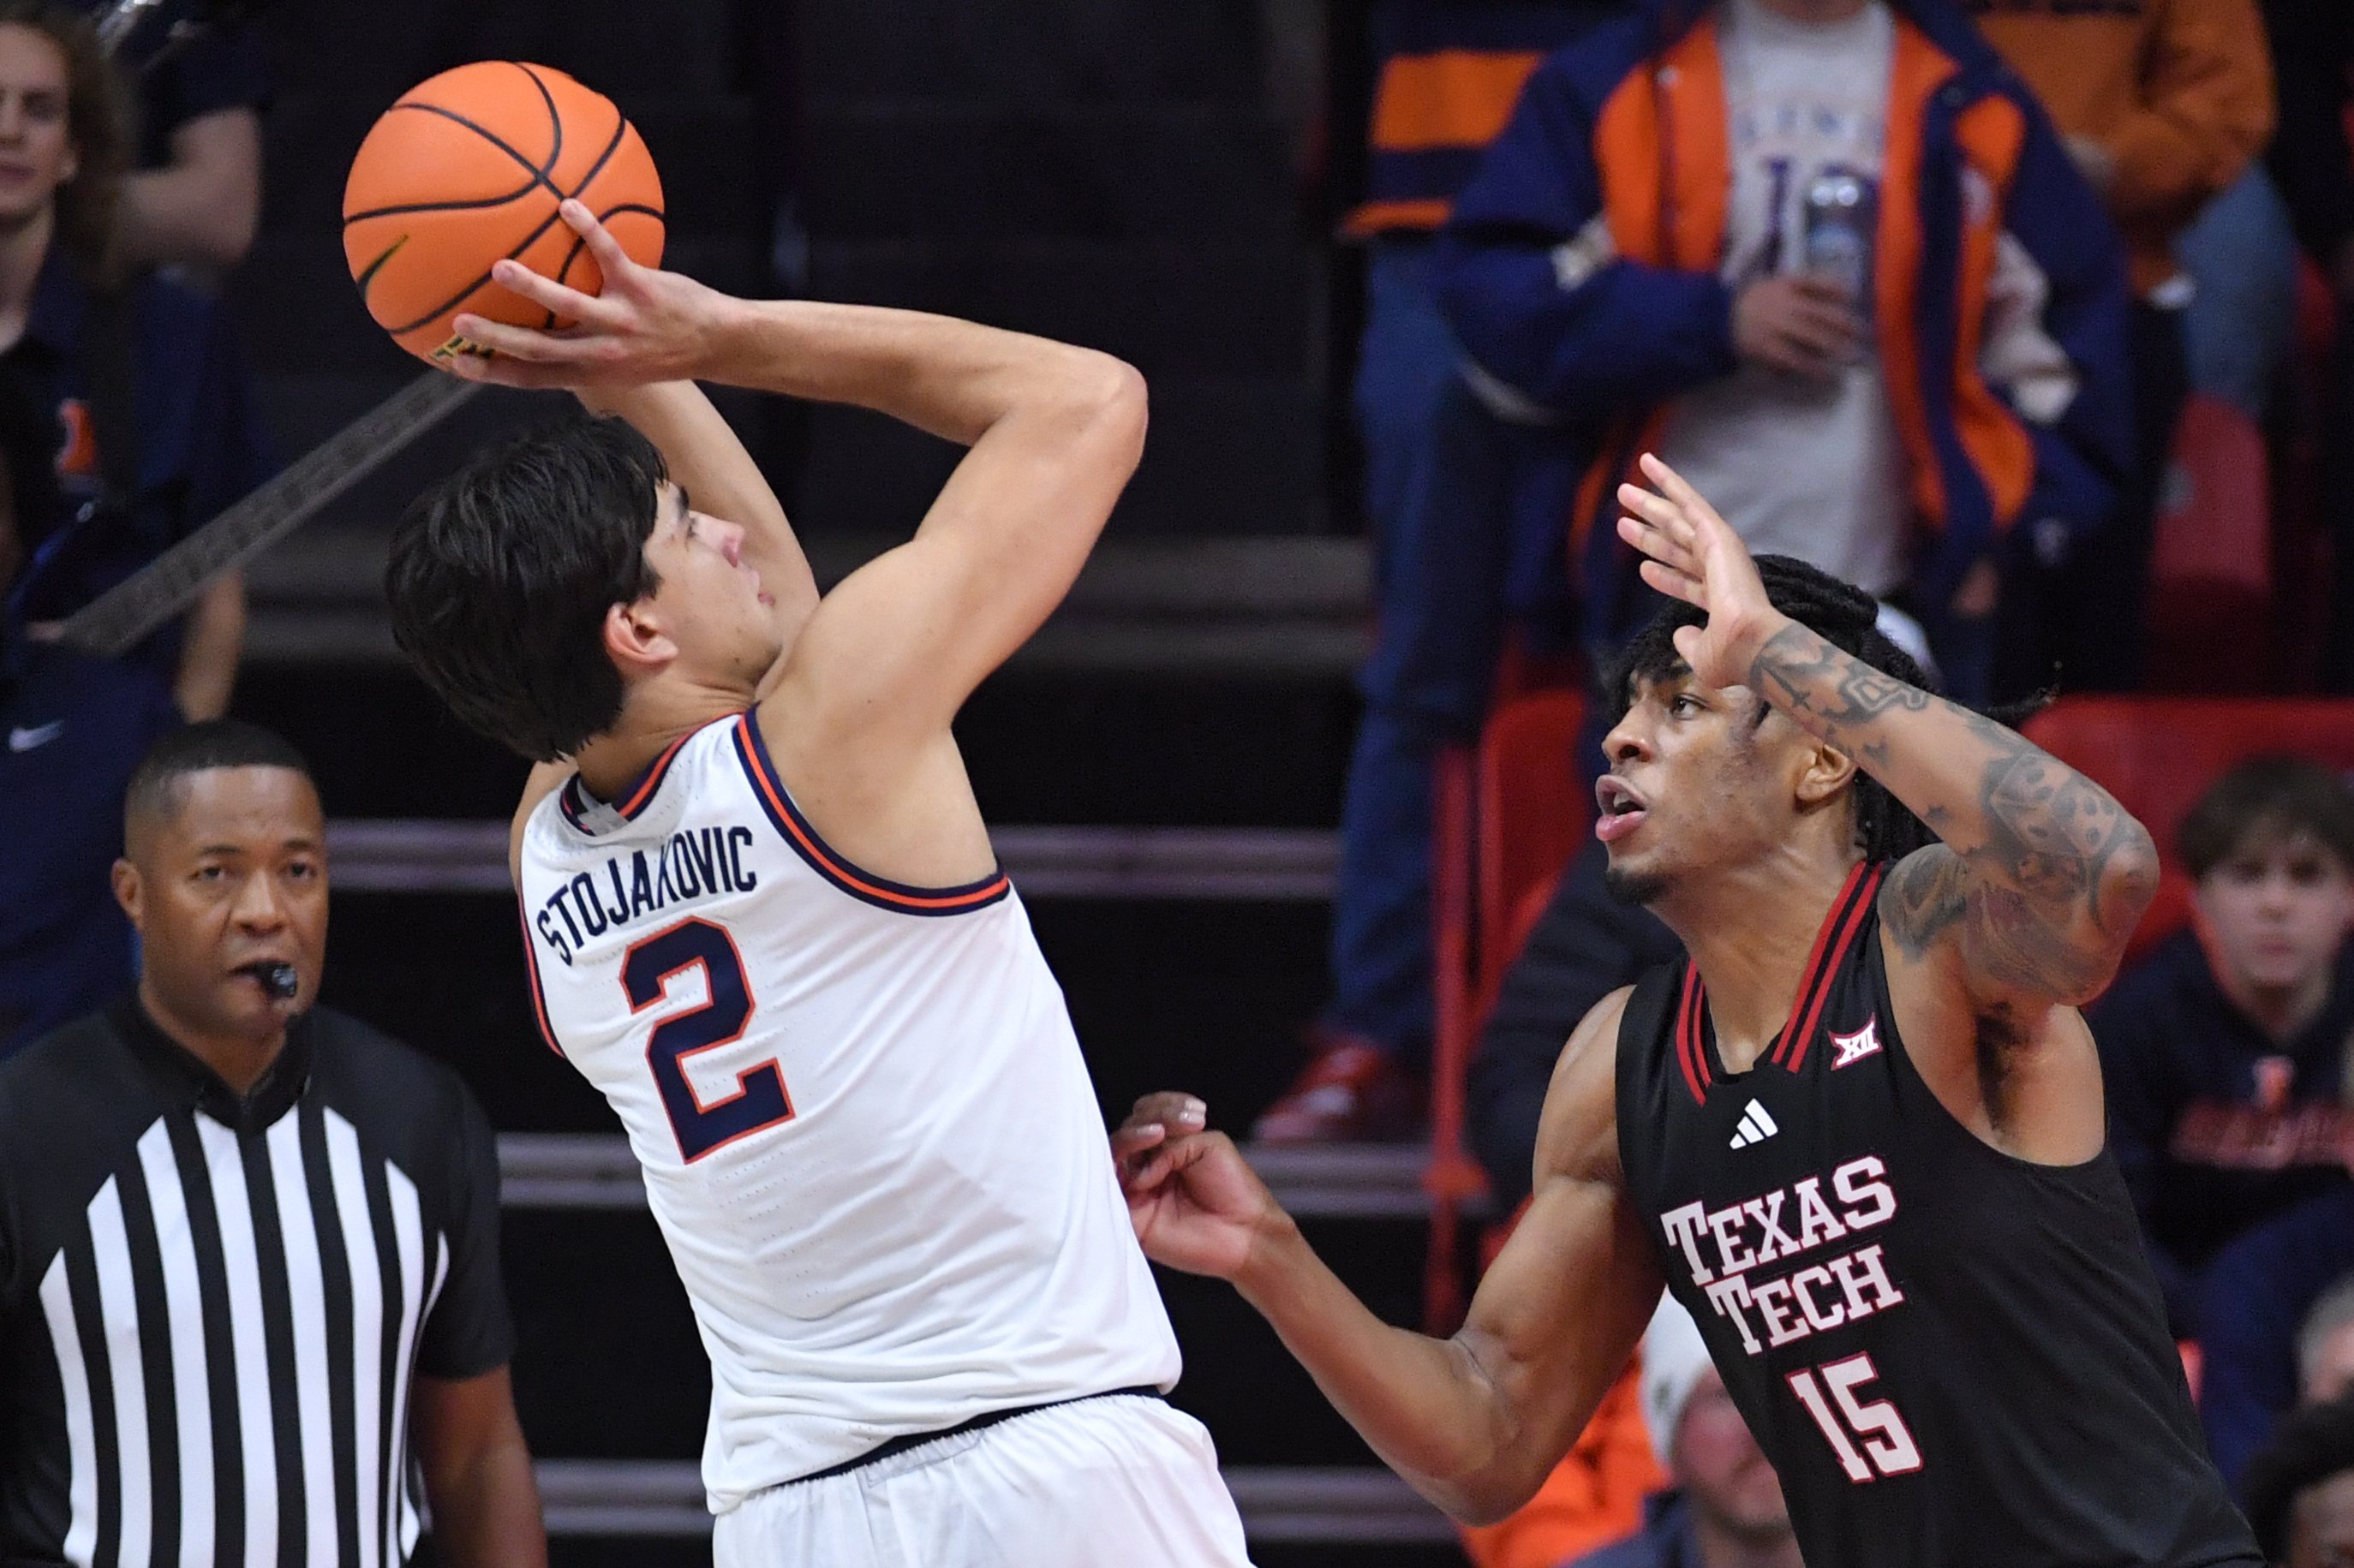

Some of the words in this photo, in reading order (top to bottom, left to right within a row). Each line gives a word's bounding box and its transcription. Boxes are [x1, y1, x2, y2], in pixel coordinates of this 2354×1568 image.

[537, 826, 757, 967] STOJAKOVIC
[618, 915, 797, 1166] 2
[1660, 1154, 1897, 1286] TEXAS
[1703, 1244, 1904, 1356] TECH
[1786, 1350, 1924, 1484] 15
